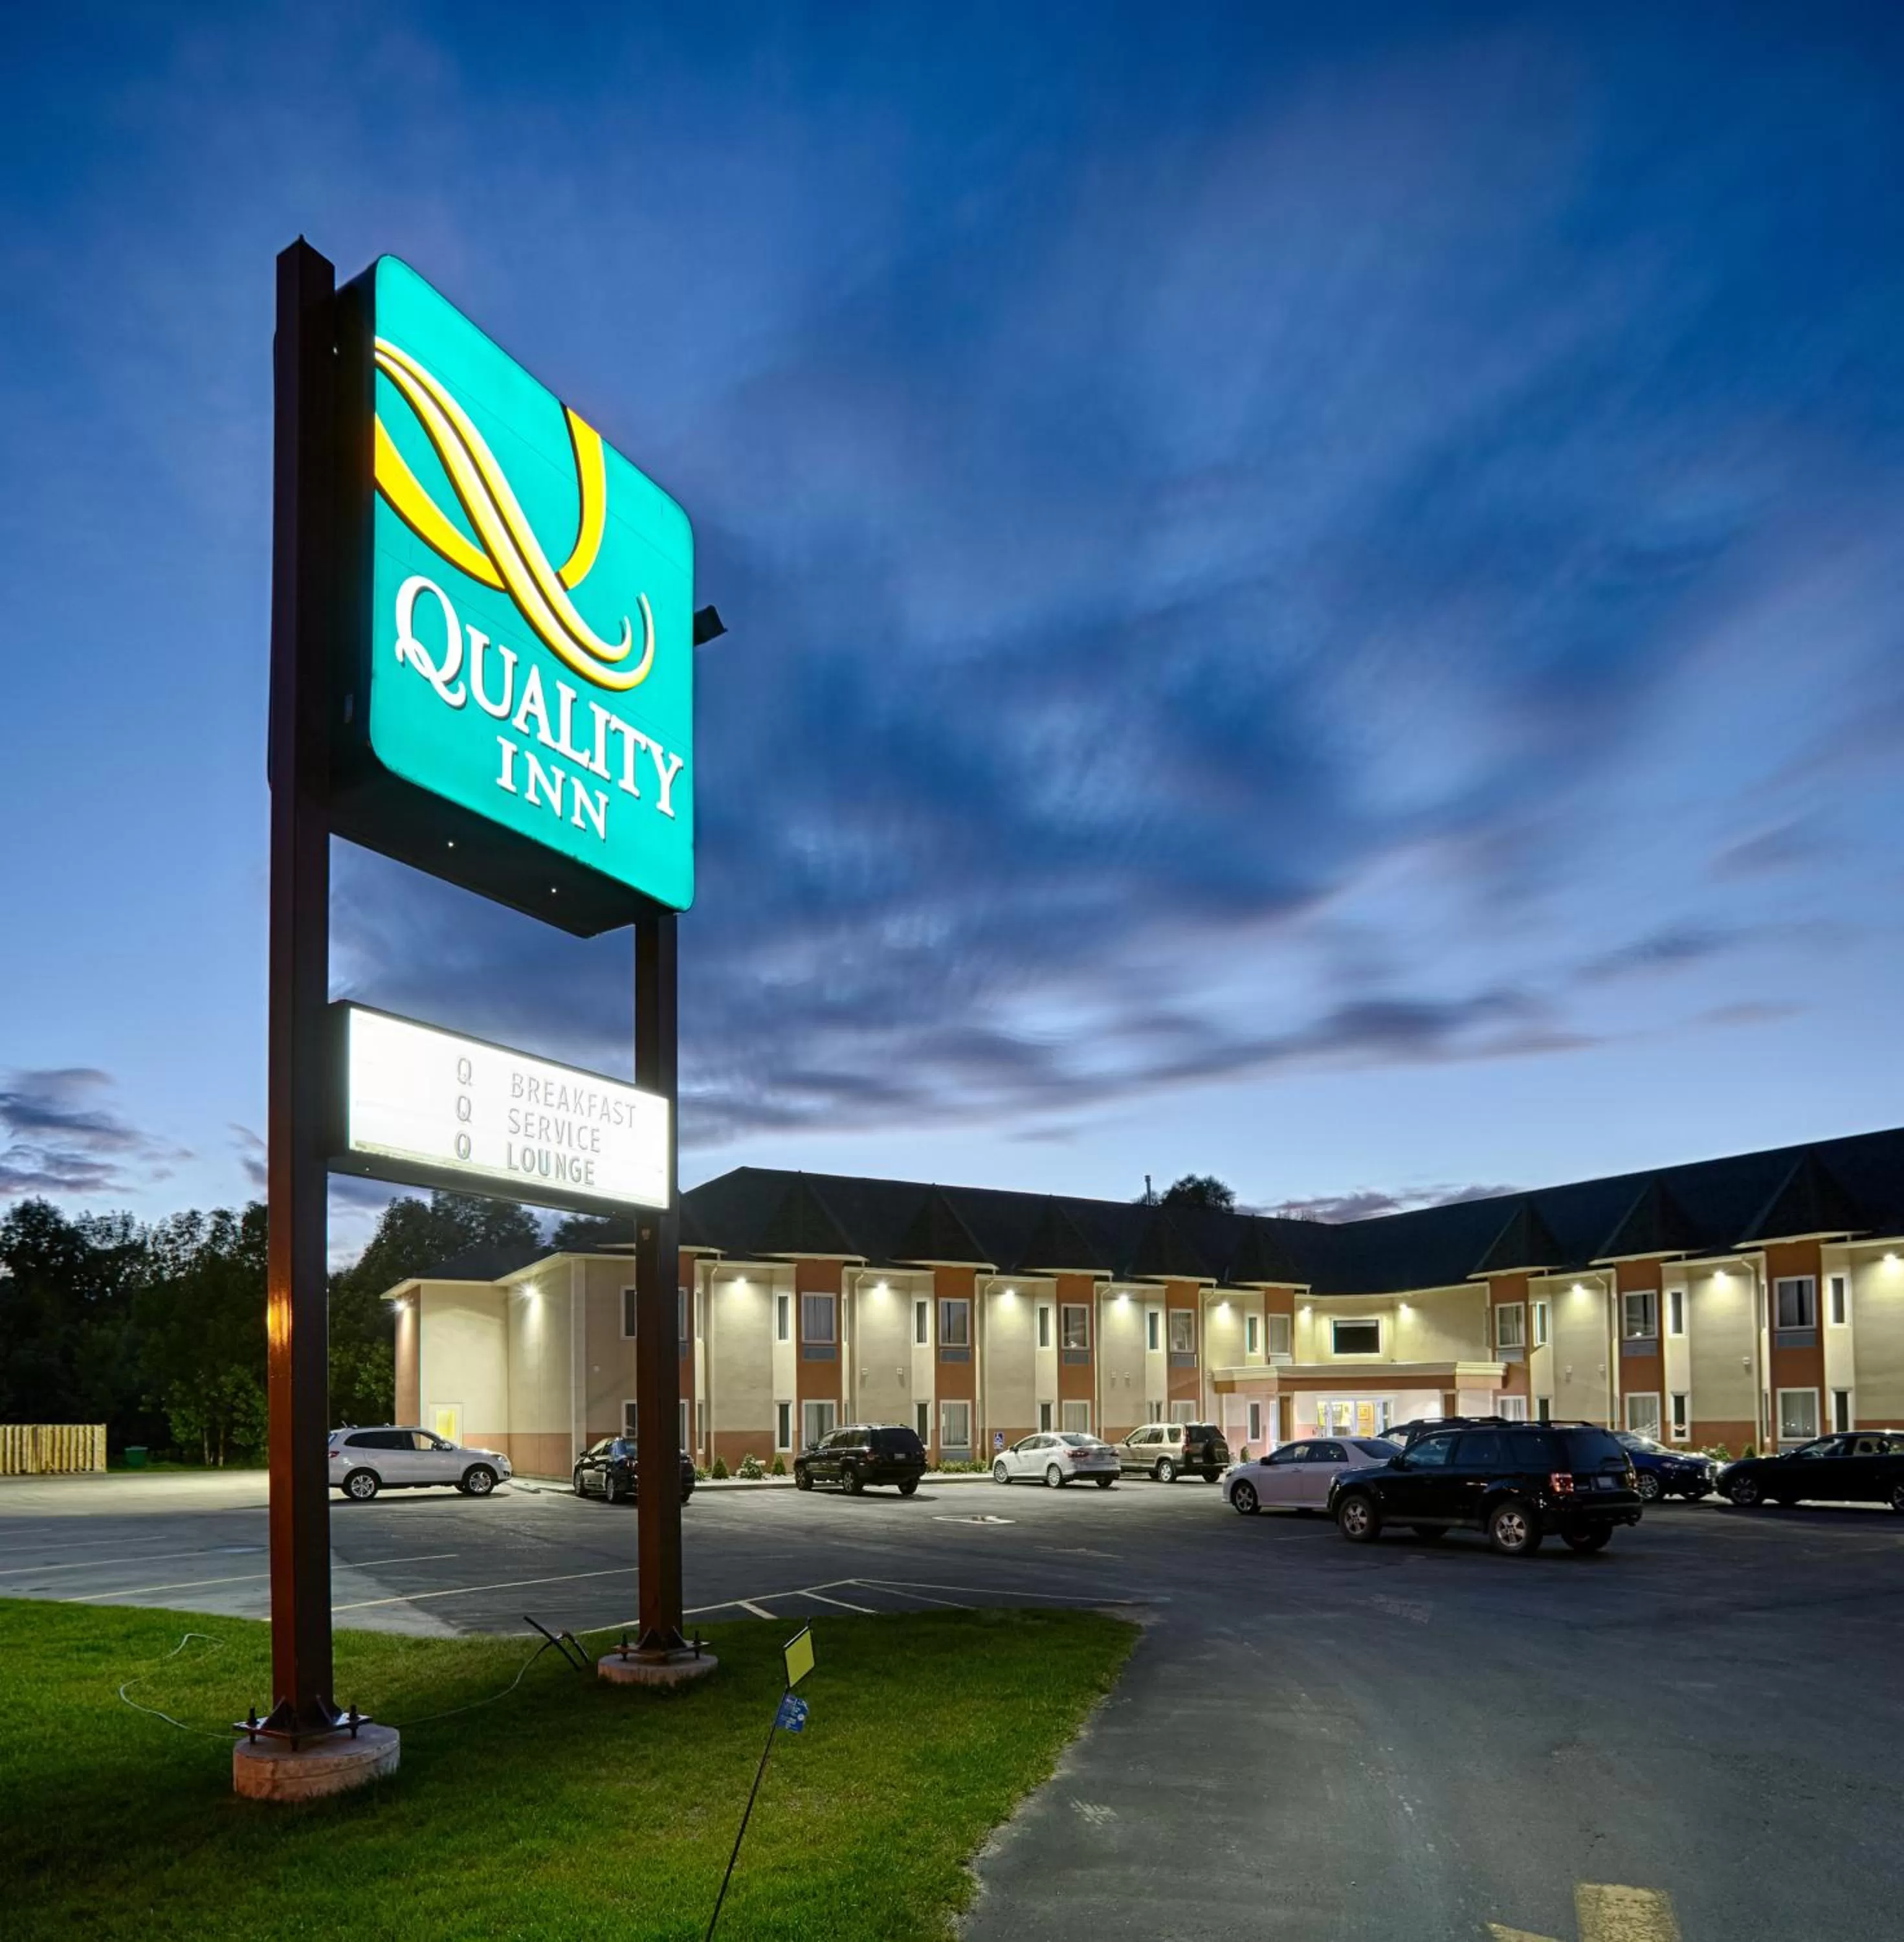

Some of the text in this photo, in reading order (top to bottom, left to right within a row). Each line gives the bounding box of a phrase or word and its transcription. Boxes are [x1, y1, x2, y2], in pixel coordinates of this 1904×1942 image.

[395, 575, 683, 818] QUALITY
[496, 736, 609, 841] INN
[456, 1096, 602, 1154] Q SERVICE
[457, 1057, 636, 1128] Q BREAKFAST
[507, 1142, 595, 1186] LOUNGE
